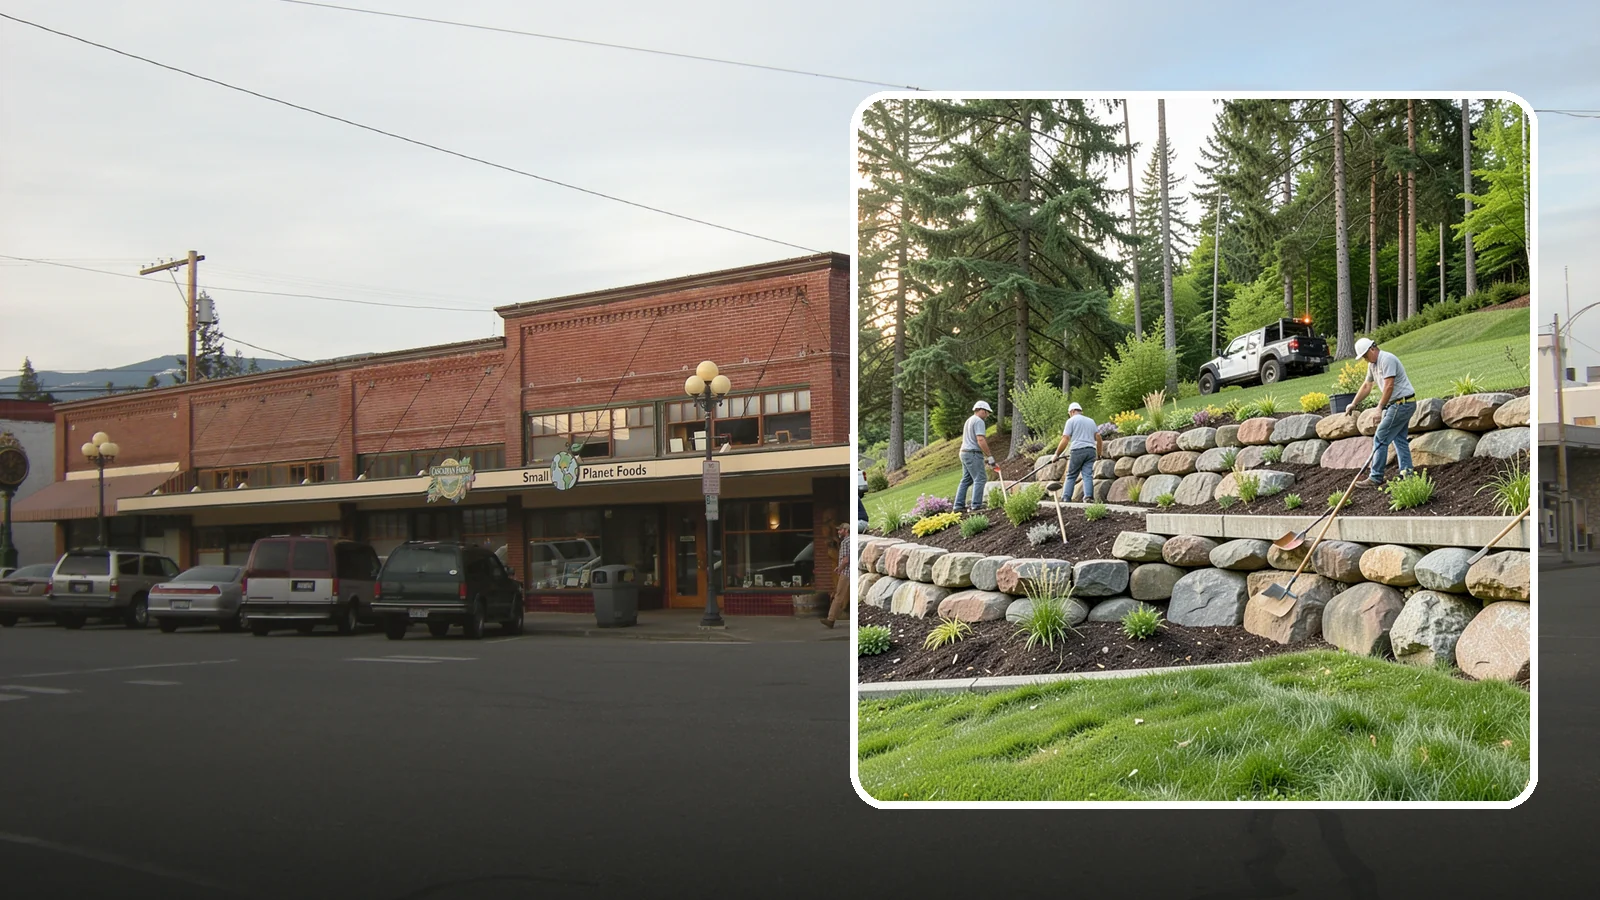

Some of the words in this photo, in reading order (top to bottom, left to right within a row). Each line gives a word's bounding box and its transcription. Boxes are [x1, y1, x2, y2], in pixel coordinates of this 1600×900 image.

[456, 466, 469, 475] FARM
[523, 471, 549, 483] Small
[583, 467, 614, 479] Planet
[617, 464, 647, 477] Foods
